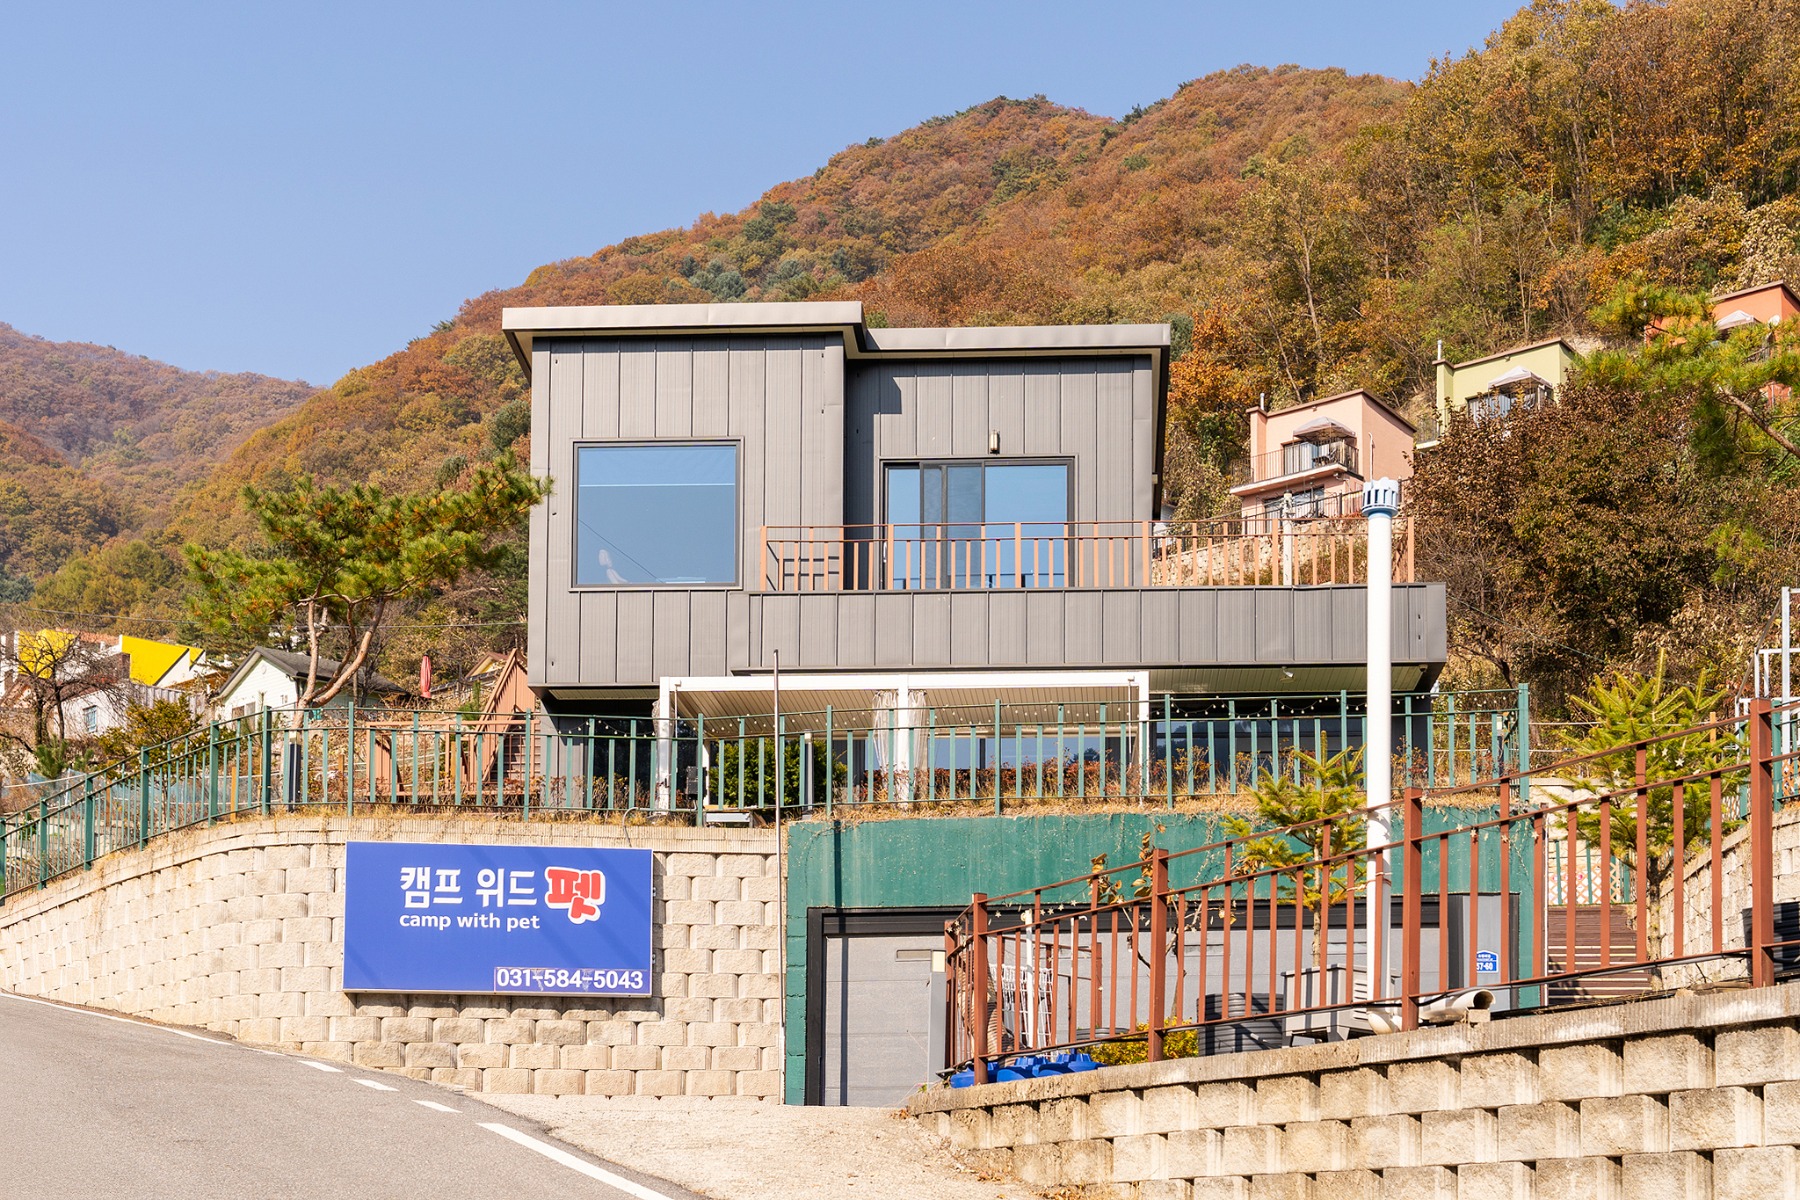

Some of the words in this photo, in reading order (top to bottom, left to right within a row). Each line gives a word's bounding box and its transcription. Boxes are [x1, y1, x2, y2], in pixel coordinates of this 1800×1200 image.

[399, 866, 463, 908] 캠프
[475, 867, 538, 908] 위드
[544, 866, 606, 924] 펫
[399, 913, 451, 931] camp
[457, 912, 501, 930] with
[507, 914, 540, 932] pet
[496, 968, 644, 989] 031-584-5043
